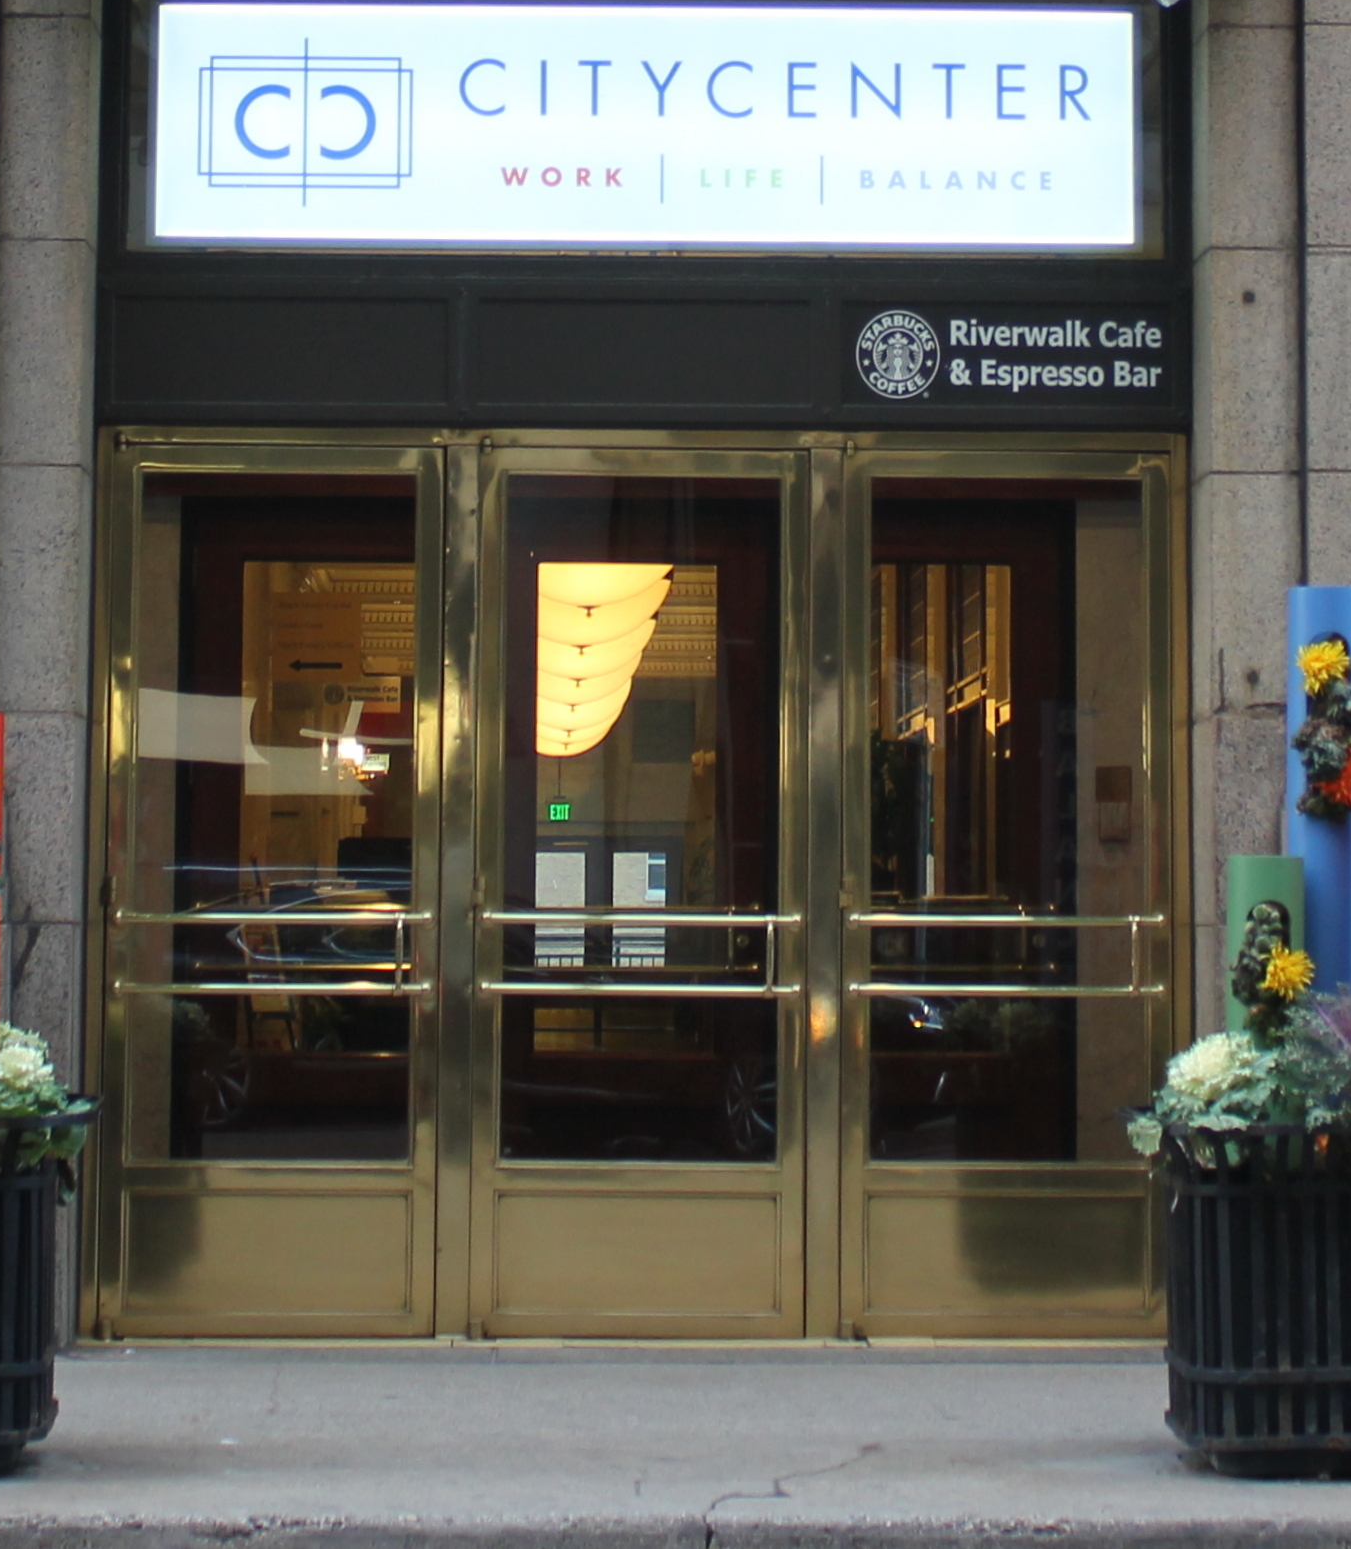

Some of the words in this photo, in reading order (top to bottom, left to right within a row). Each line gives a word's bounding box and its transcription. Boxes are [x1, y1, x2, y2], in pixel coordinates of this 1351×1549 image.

[458, 57, 1093, 123] CITYCENTER
[501, 166, 624, 188] WORK
[699, 169, 784, 189] LIFE
[859, 169, 1053, 191] BALANCE
[860, 314, 936, 351] STARBUCKS
[949, 319, 1091, 348] Riverwalk
[1098, 321, 1162, 348] Cafe
[868, 371, 927, 395] COFFEE
[949, 359, 972, 386] &
[981, 359, 1105, 392] Espresso
[1114, 361, 1162, 387] Bar
[549, 803, 570, 821] EXIT
